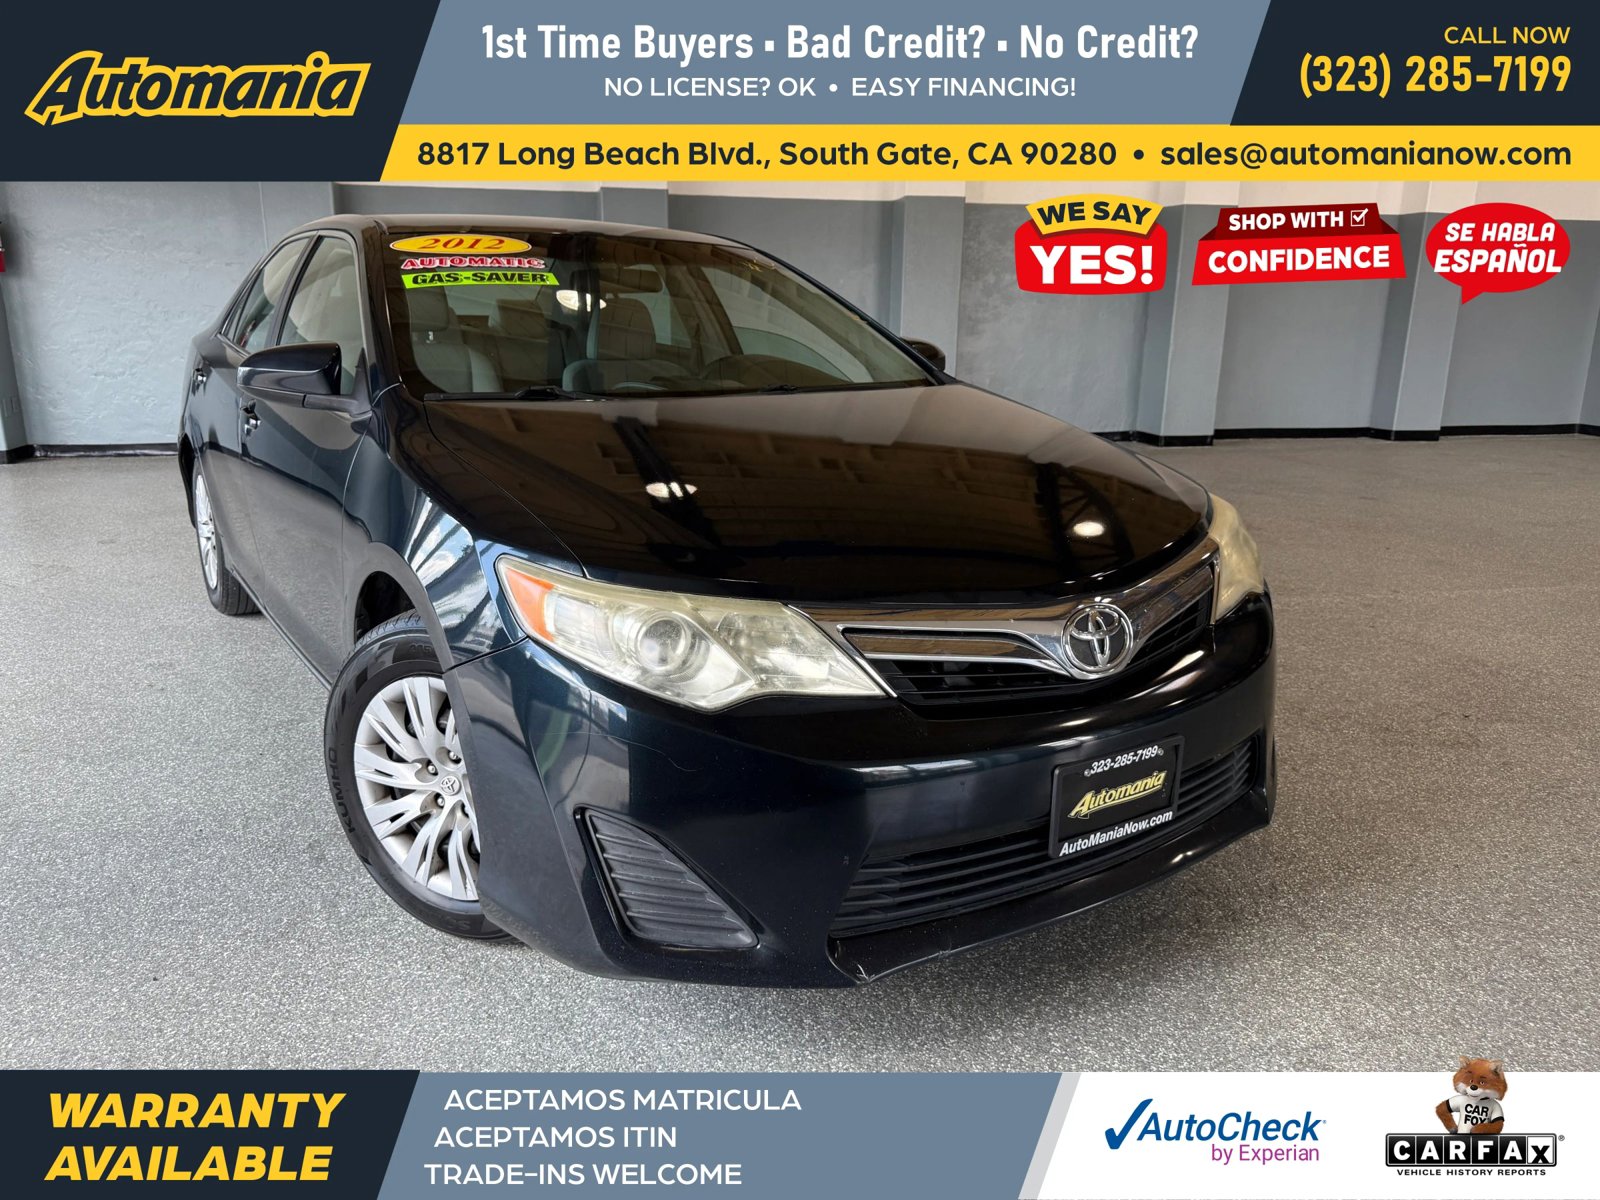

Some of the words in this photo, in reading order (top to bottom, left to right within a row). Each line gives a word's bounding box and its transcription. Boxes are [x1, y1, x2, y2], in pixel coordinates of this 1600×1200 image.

[420, 237, 506, 250] 2012
[401, 256, 545, 269] AUTOMATIC
[412, 272, 549, 285] GAS-SAVER
[1090, 745, 1158, 774] 323-285-7199
[328, 747, 356, 834] KUMHO
[1068, 770, 1167, 819] Automania
[1059, 811, 1173, 856] AutoManiaNow.com
